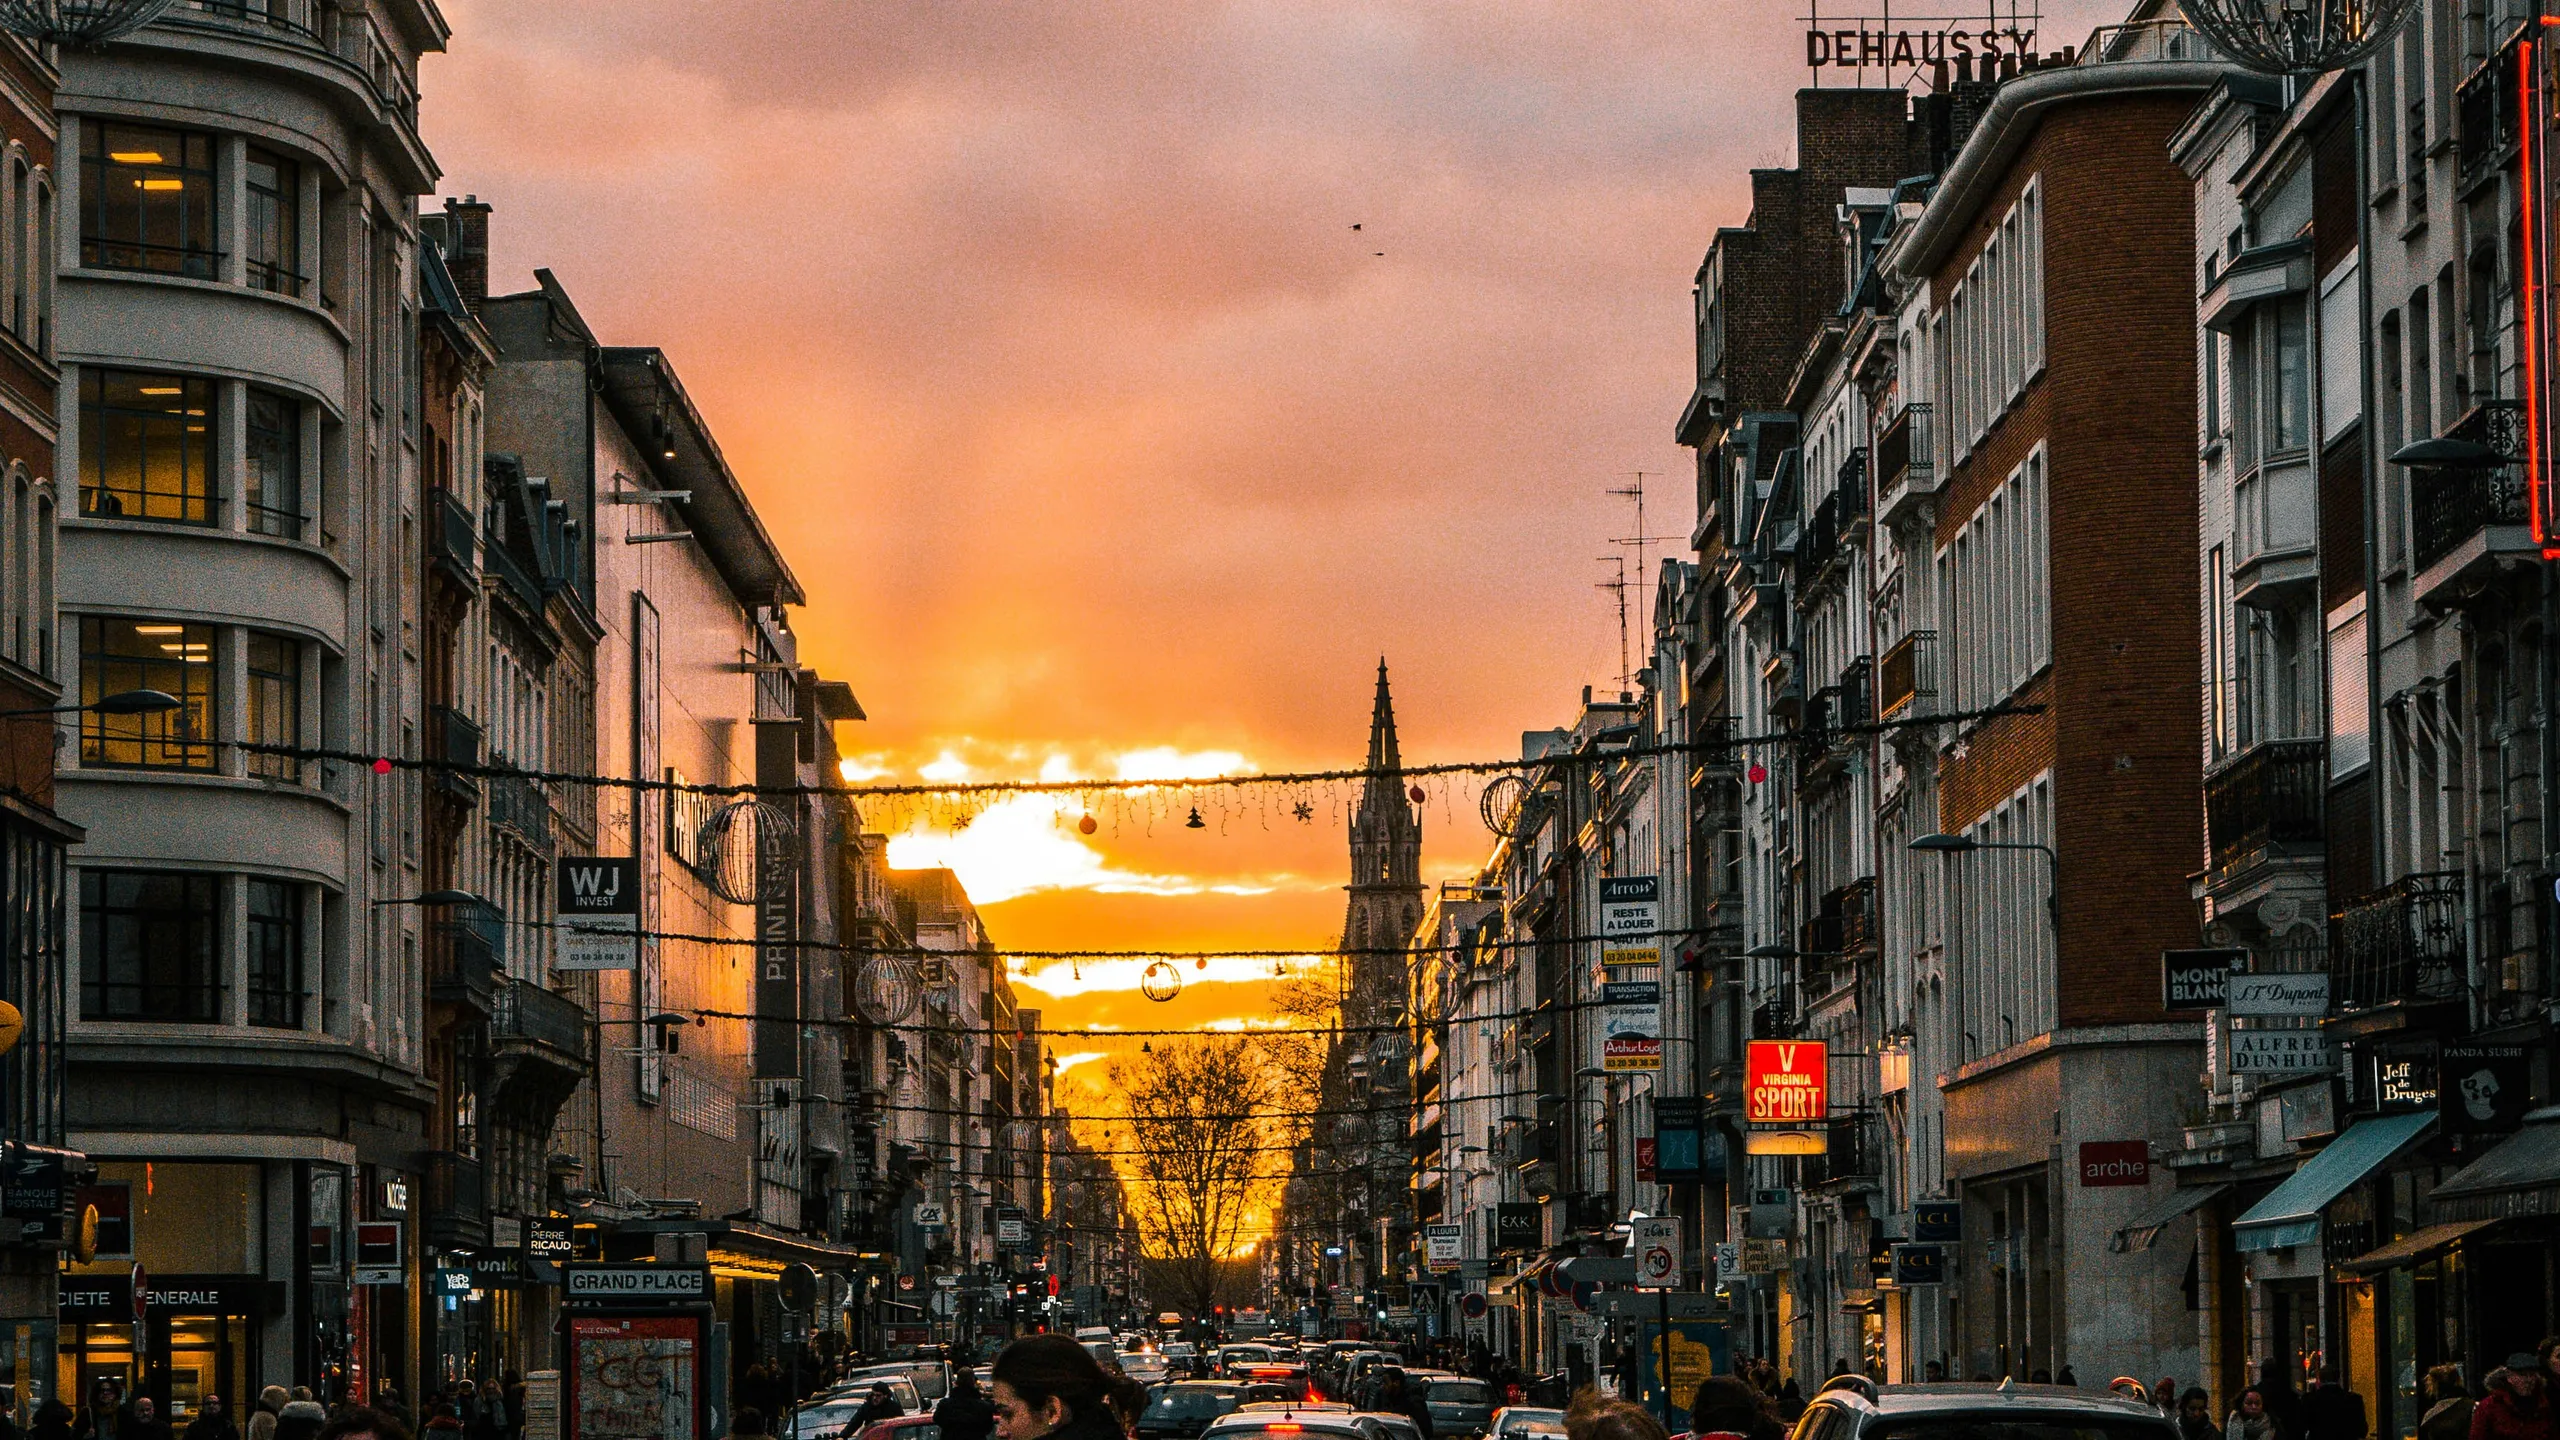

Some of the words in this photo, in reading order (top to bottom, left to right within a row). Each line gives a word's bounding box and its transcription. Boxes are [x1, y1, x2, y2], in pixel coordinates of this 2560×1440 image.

[1806, 30, 2035, 68] DEHAUSSY
[569, 866, 619, 896] WJ
[1605, 880, 1655, 896] Arrow
[576, 896, 614, 906] INVEST
[764, 828, 788, 981] PRINTMP
[1613, 908, 1648, 918] RESTE
[1607, 920, 1615, 930] A
[1618, 919, 1654, 929] LOUER
[1606, 952, 1615, 961] 03
[1617, 952, 1625, 961] 20
[2171, 967, 2228, 984] MONT
[1607, 985, 1656, 993] TRANSACTION
[2267, 984, 2329, 1006] Dupont
[1606, 1041, 1637, 1053] Arthur
[2241, 1037, 2329, 1051] ALFRED
[1778, 1045, 1796, 1073] V
[2444, 1047, 2485, 1058] PANDA
[2488, 1047, 2523, 1057] SUSHI
[2236, 1052, 2340, 1068] DUNHILL
[2383, 1062, 2411, 1081] Jeff
[1762, 1074, 1812, 1085] VIRGINIA
[2398, 1080, 2410, 1088] de
[2383, 1083, 2436, 1103] Bruges
[1754, 1086, 1820, 1117] SPORT
[2087, 1158, 2145, 1178] arche
[7, 1188, 57, 1198] BANQUE
[7, 1199, 57, 1209] POSTALE
[1916, 1211, 1956, 1225] LCL
[531, 1221, 542, 1229] Dr
[1437, 1227, 1458, 1235] LOUER
[1643, 1224, 1672, 1237] ZONE
[531, 1230, 565, 1240] PIERRE
[530, 1240, 572, 1250] RICAUD
[1744, 1241, 1764, 1250] Jean
[1652, 1255, 1667, 1269] 30
[1744, 1251, 1769, 1261] Louis
[477, 1256, 520, 1273] unik
[1744, 1262, 1770, 1272] David
[573, 1274, 637, 1289] GRAND
[643, 1274, 702, 1289] PLACE
[59, 1291, 111, 1306] CIETE
[146, 1291, 219, 1305] ENERALE
